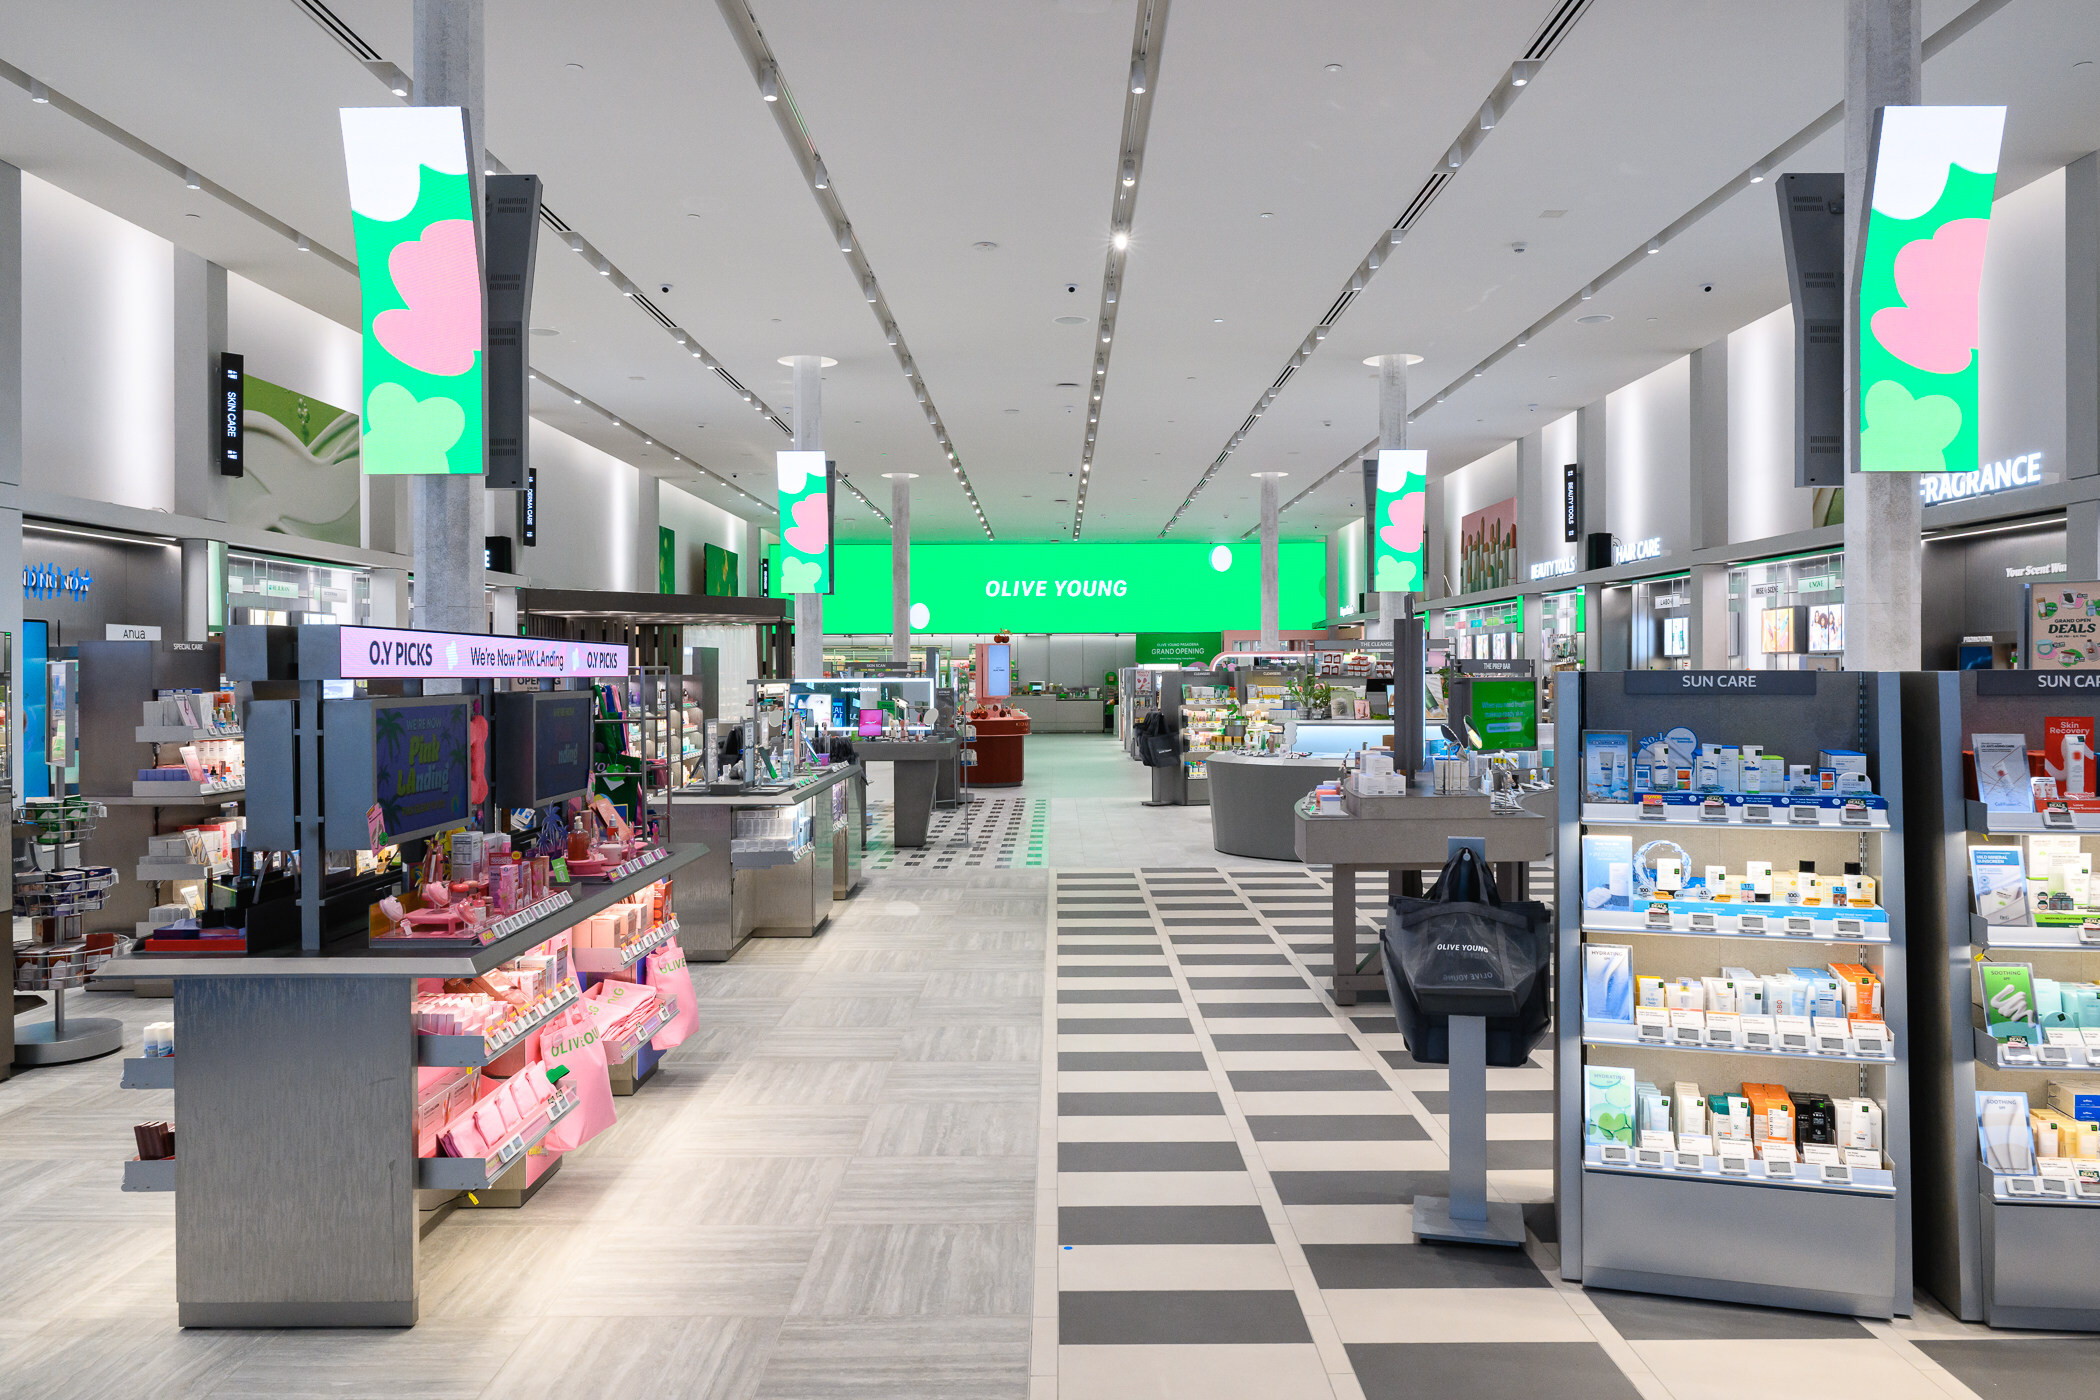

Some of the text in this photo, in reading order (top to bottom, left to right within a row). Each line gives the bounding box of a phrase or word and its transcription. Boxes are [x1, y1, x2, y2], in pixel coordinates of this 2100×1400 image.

[227, 391, 237, 438] SKIN CARE
[1615, 537, 1661, 566] HAIR CARE
[1530, 559, 1556, 580] BEAUTY
[2006, 567, 2024, 578] Your
[2025, 565, 2050, 576] Scent
[985, 579, 1128, 597] OLIVE YOUNG
[123, 629, 146, 640] Anua
[2048, 623, 2096, 634] DEALS
[369, 640, 433, 666] O.Y PICKS
[470, 647, 495, 666] We're
[497, 648, 515, 667] Now
[587, 651, 618, 669] O.Y PICKS
[1682, 675, 1757, 688] SUN CARE
[2037, 675, 2071, 688] SUN
[2049, 727, 2090, 735] Recovery
[2060, 721, 2079, 729] Skin
[1639, 731, 1665, 749] No.1
[408, 733, 441, 766] Pink
[397, 761, 449, 797] LAnding
[1437, 943, 1489, 953] OLIVE YOUNG
